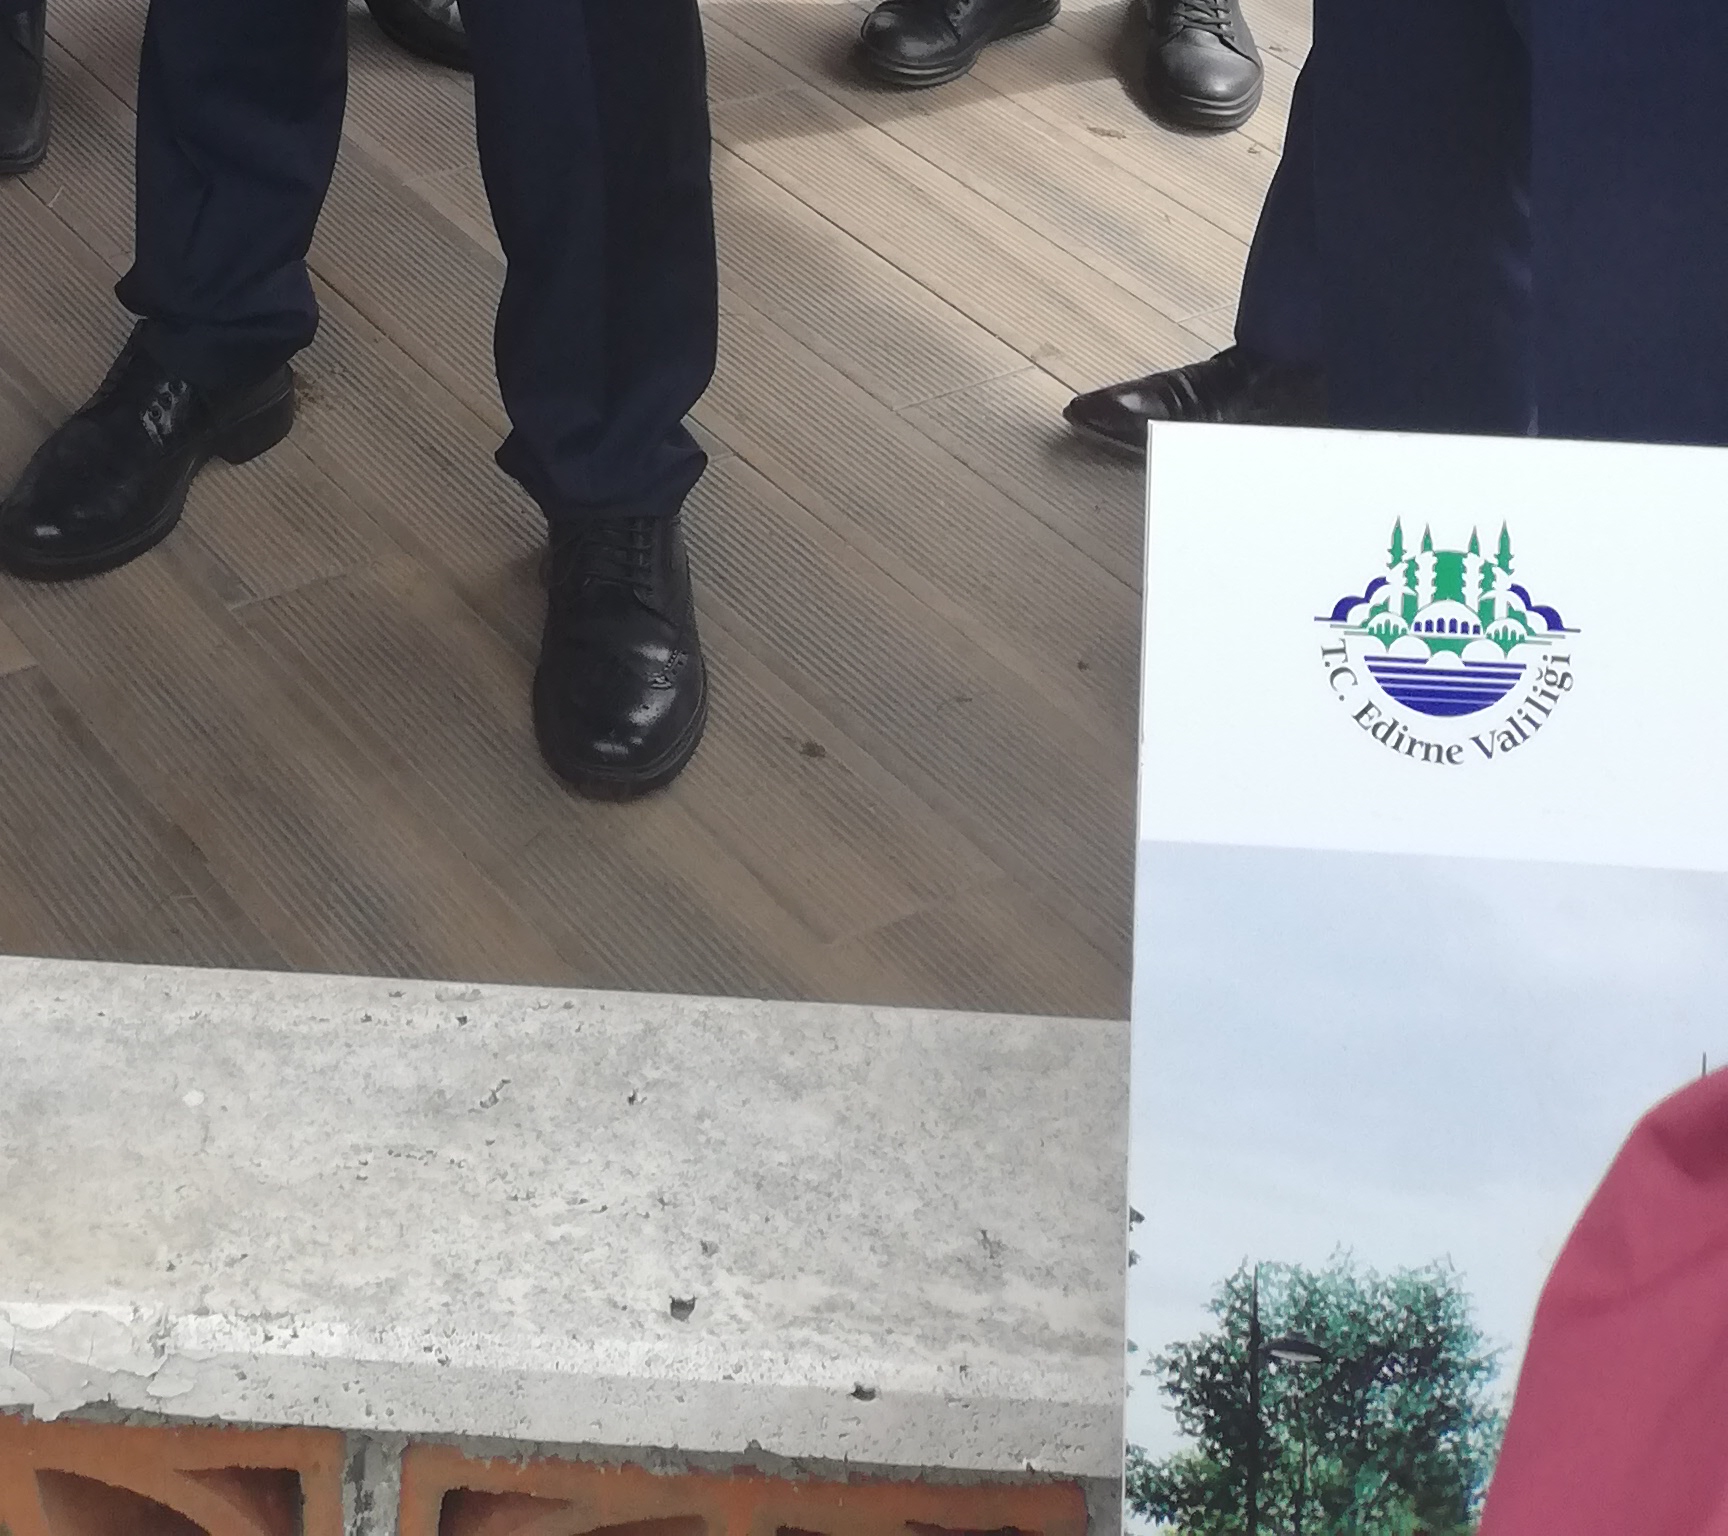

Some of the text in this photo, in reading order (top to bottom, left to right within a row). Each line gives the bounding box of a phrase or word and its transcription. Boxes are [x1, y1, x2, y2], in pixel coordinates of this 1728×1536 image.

[1320, 638, 1574, 765] T.C. Edirne Valiliği
